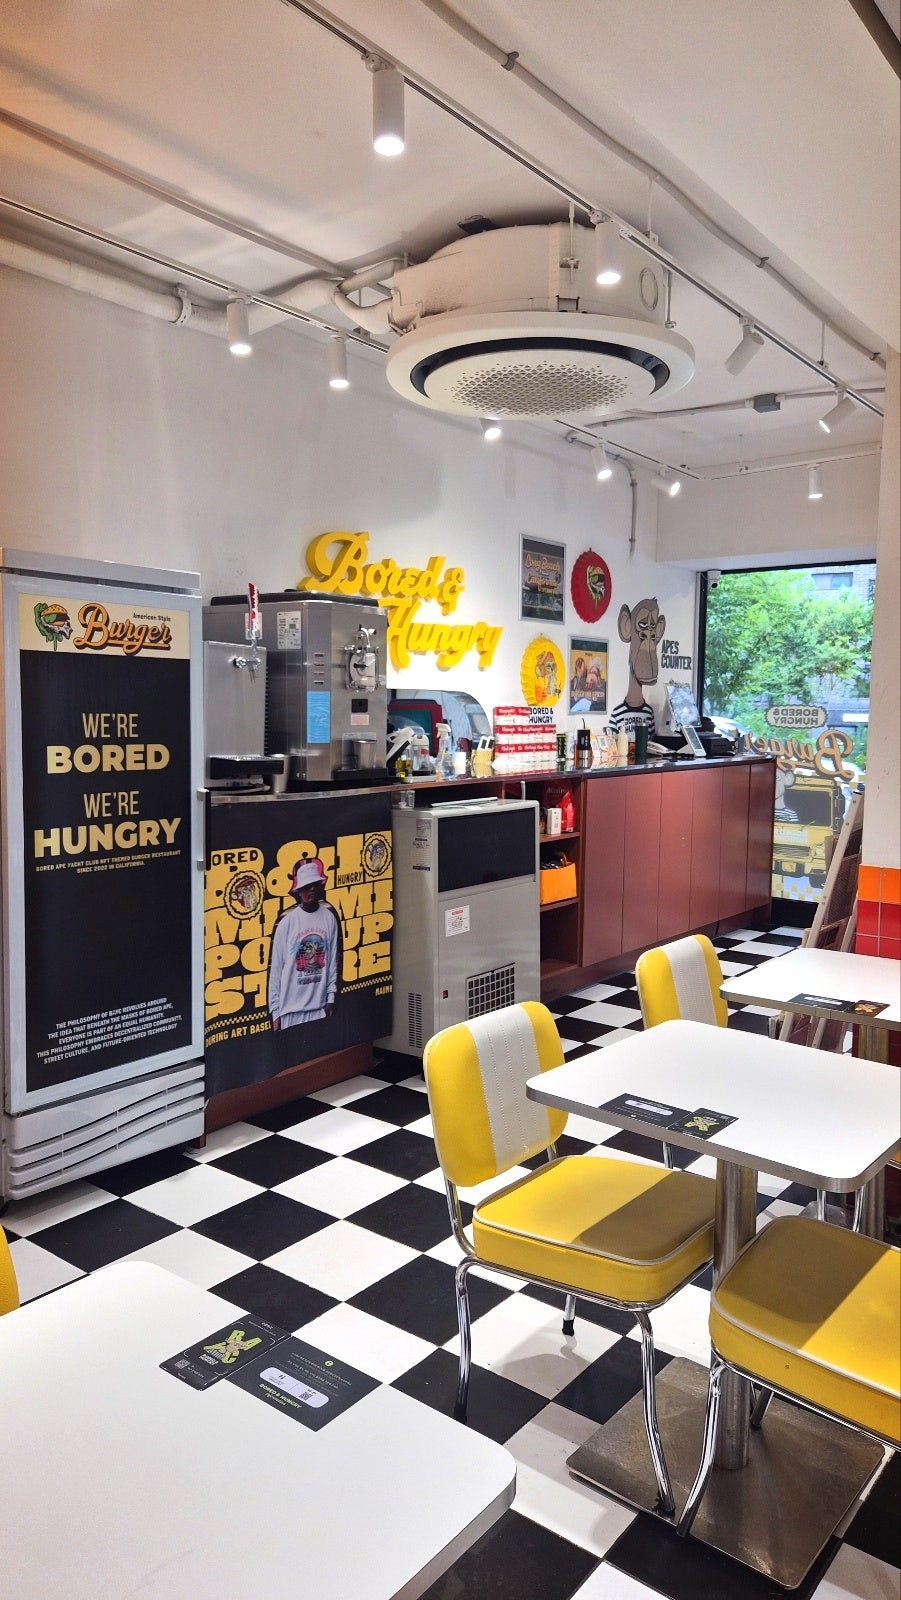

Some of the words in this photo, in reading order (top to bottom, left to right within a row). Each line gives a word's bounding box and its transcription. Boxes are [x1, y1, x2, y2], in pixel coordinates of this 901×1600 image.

[297, 531, 446, 600] Bored
[438, 567, 466, 616] &
[73, 602, 172, 656] Burger
[378, 598, 504, 672] Hungry
[662, 640, 679, 654] APES
[661, 654, 692, 670] COUNTER
[82, 713, 138, 738] WE'RE
[46, 744, 170, 774] BORED
[83, 791, 140, 819] WE'RE
[34, 817, 182, 858] HUNGRY
[68, 860, 84, 868] YACHT
[132, 853, 150, 861] BURGER
[152, 850, 181, 858] RESTAURANT
[116, 860, 144, 869] CALIFORNIA
[212, 850, 258, 866] ORED
[338, 871, 363, 886] HUNGRY
[56, 1021, 67, 1030] THE
[67, 1013, 100, 1027] PHILOSOPHY
[122, 1002, 146, 1014] REVOLVES
[147, 998, 167, 1007] AROUND
[59, 1028, 72, 1037] IDEA
[73, 1025, 86, 1034] THAT
[87, 1019, 110, 1030] BENEATH
[120, 1012, 138, 1021] MASKS
[146, 1006, 162, 1015] BORED
[37, 1050, 49, 1058] THIS
[51, 1040, 84, 1055] PHILOSOPHY
[85, 1032, 113, 1045] EMBRACES
[114, 1023, 152, 1038] DECENTRALIZED
[44, 1054, 64, 1064] STREET
[90, 1043, 102, 1052] AND
[103, 1032, 146, 1048] FUTURE-ORIENTED
[147, 1023, 177, 1036] TECHNOLOGY
[58, 1034, 86, 1045] EVERYONE
[93, 1027, 106, 1036] PART
[122, 1018, 138, 1028] EQUAL
[231, 1026, 247, 1038] ART
